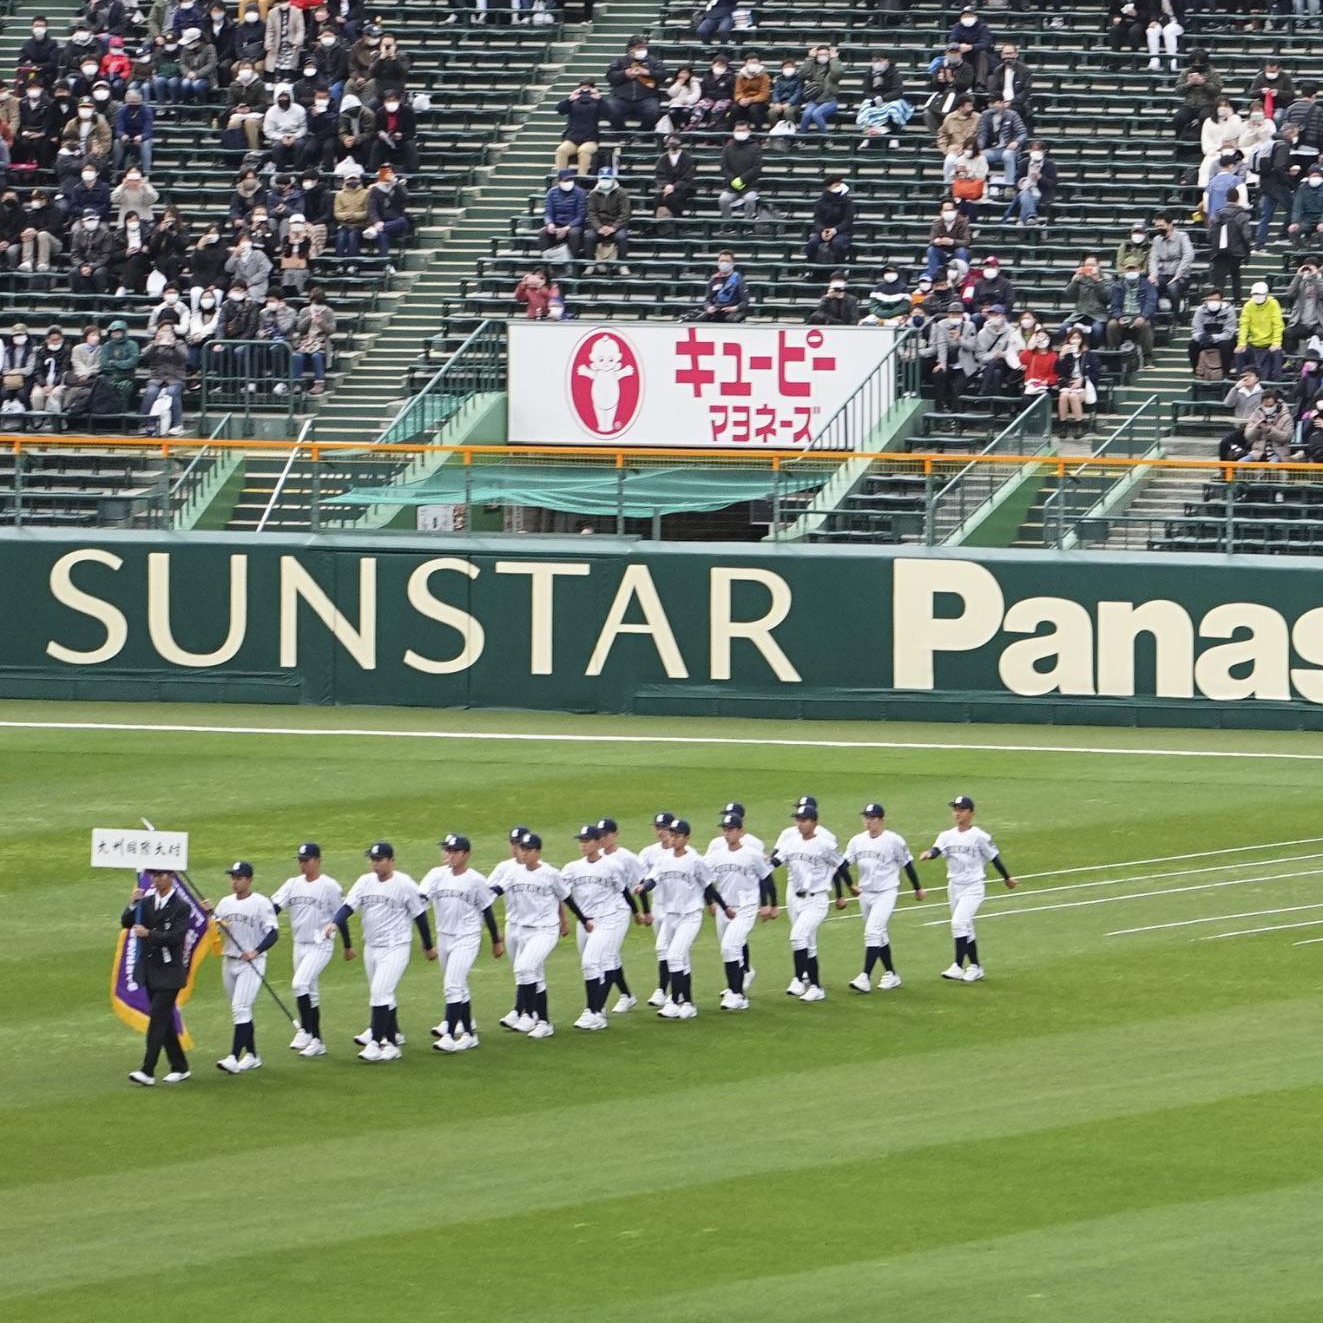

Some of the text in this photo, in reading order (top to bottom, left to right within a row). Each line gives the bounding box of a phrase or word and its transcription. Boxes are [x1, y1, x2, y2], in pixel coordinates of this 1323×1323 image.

[675, 327, 836, 398] キューピー
[708, 403, 820, 443] マヨネーズ
[46, 548, 802, 683] SUNSTAR
